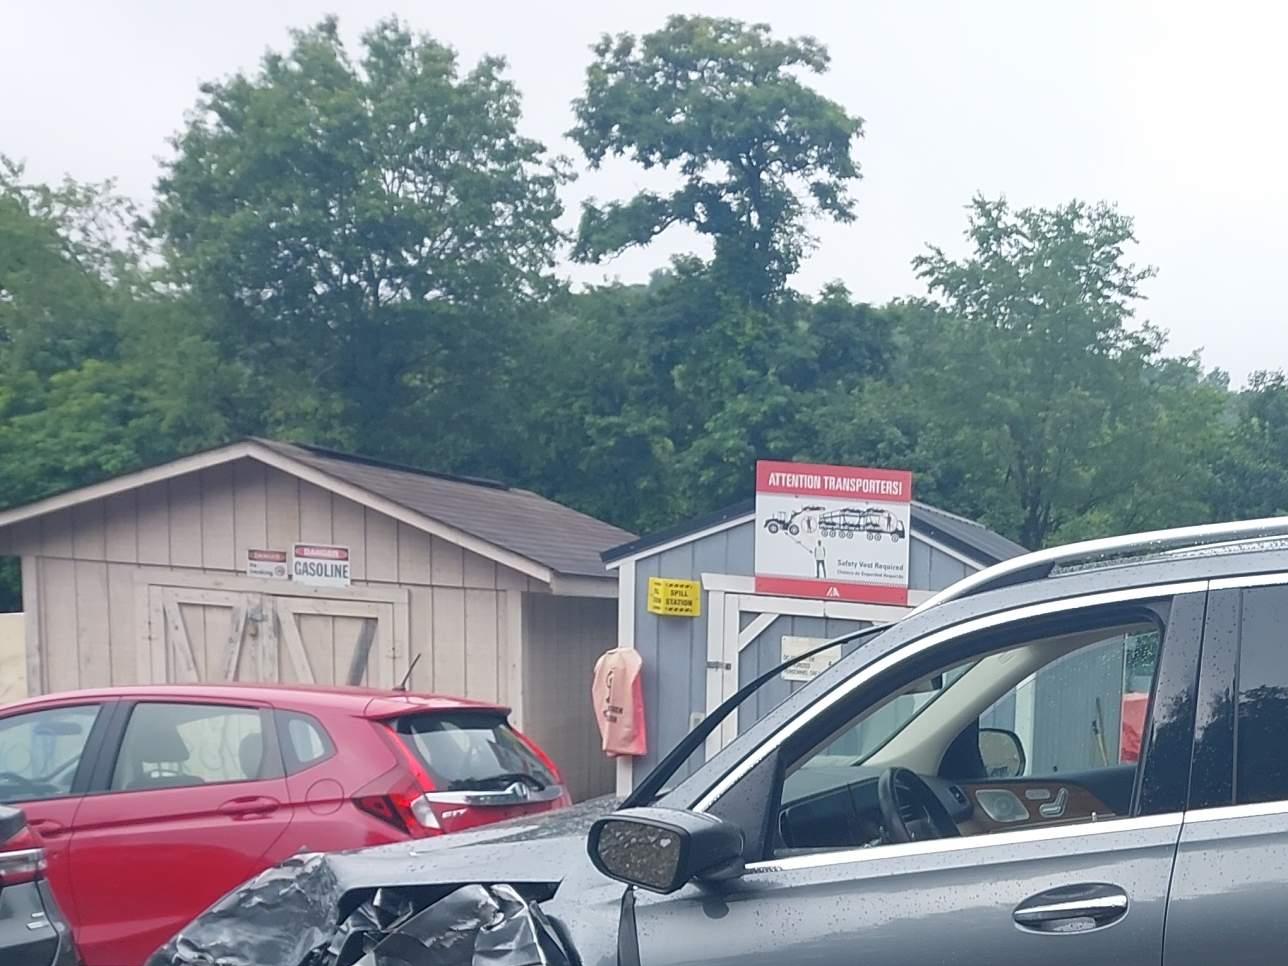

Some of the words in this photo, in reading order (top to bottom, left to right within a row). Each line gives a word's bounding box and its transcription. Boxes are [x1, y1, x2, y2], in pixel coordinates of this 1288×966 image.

[768, 472, 821, 489] ATTENTION
[823, 476, 903, 496] TRANSPORTERS!
[294, 561, 349, 578] GASOLINE
[837, 559, 858, 569] Safety
[859, 561, 874, 569] Vest
[875, 562, 904, 571] Required
[670, 589, 689, 597] SPILL
[665, 598, 693, 606] STATION
